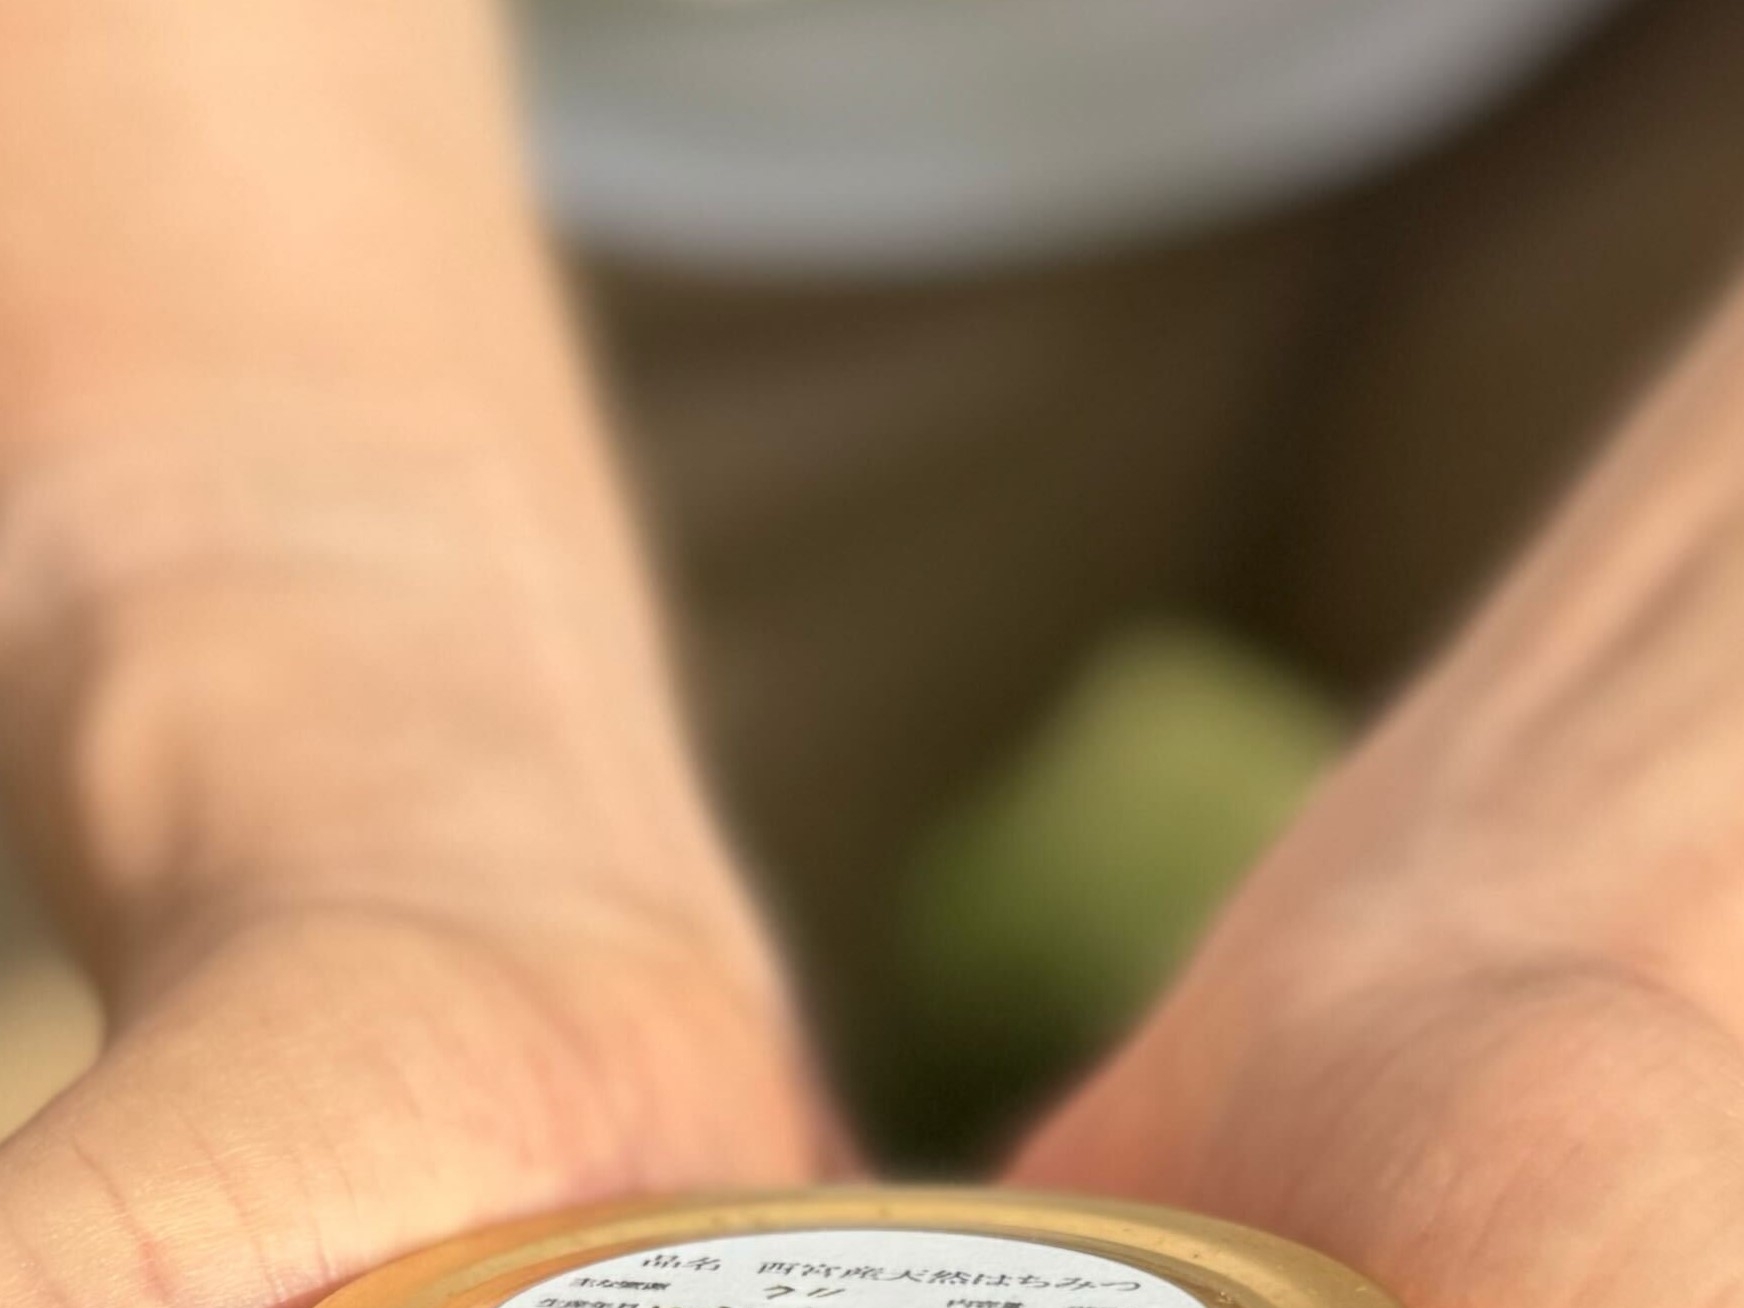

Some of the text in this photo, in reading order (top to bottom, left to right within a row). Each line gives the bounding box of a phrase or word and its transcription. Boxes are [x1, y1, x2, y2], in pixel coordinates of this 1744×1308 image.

[642, 1255, 1141, 1291] 品名 西宮産天然はちみつ
